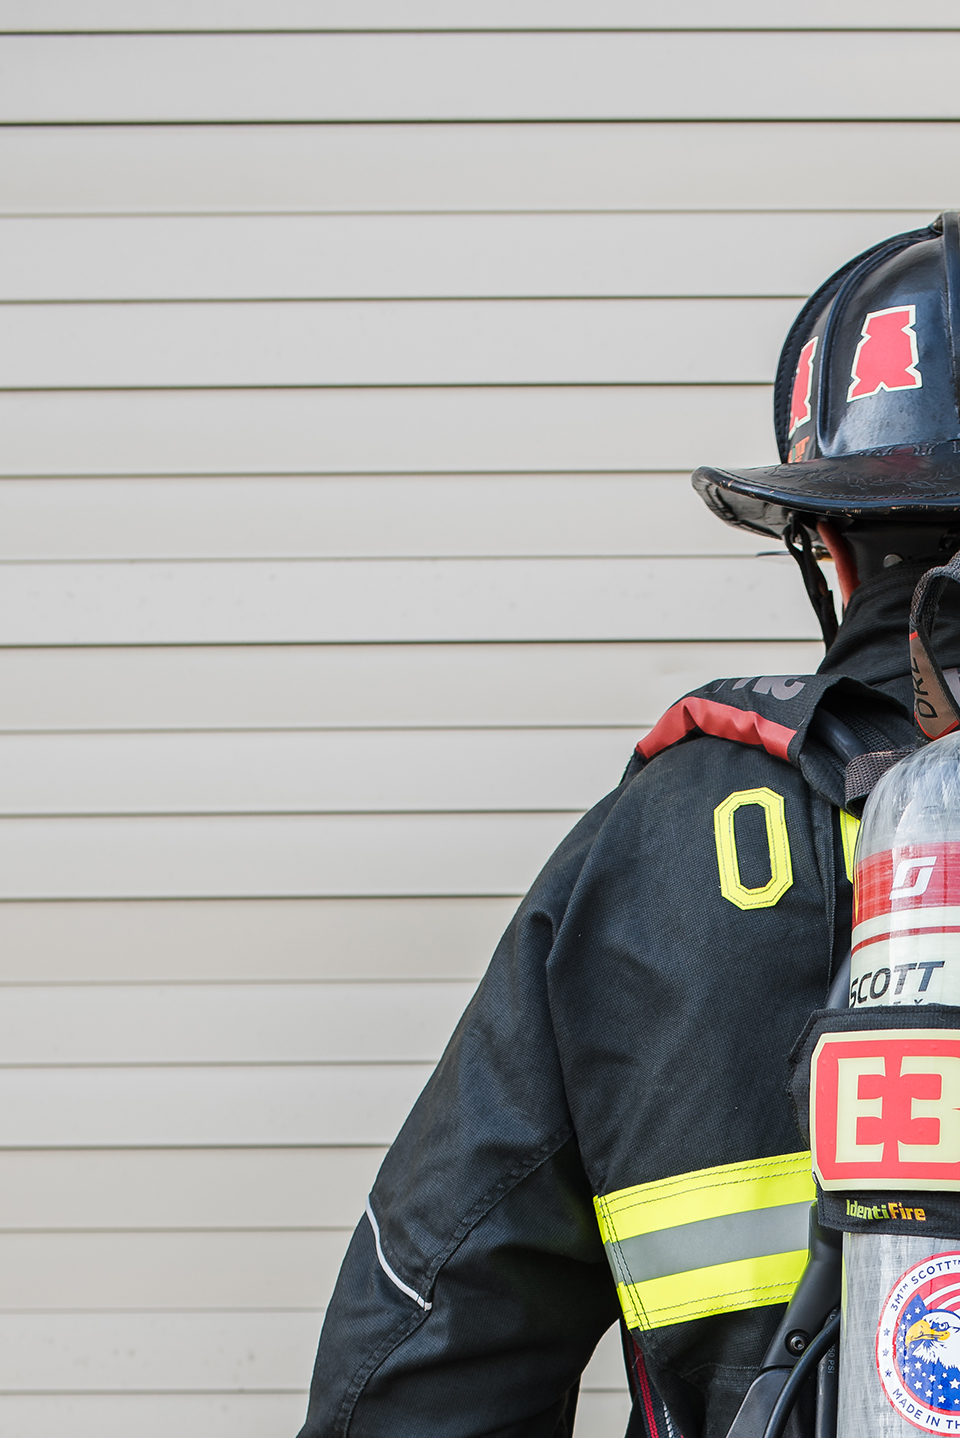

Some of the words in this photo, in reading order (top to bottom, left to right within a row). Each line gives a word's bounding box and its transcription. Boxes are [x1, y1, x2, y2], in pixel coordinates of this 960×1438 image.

[850, 961, 945, 1007] SCOTT
[846, 1199, 927, 1221] IdentiFire
[892, 1387, 924, 1420] MADE
[926, 1414, 941, 1428] IN
